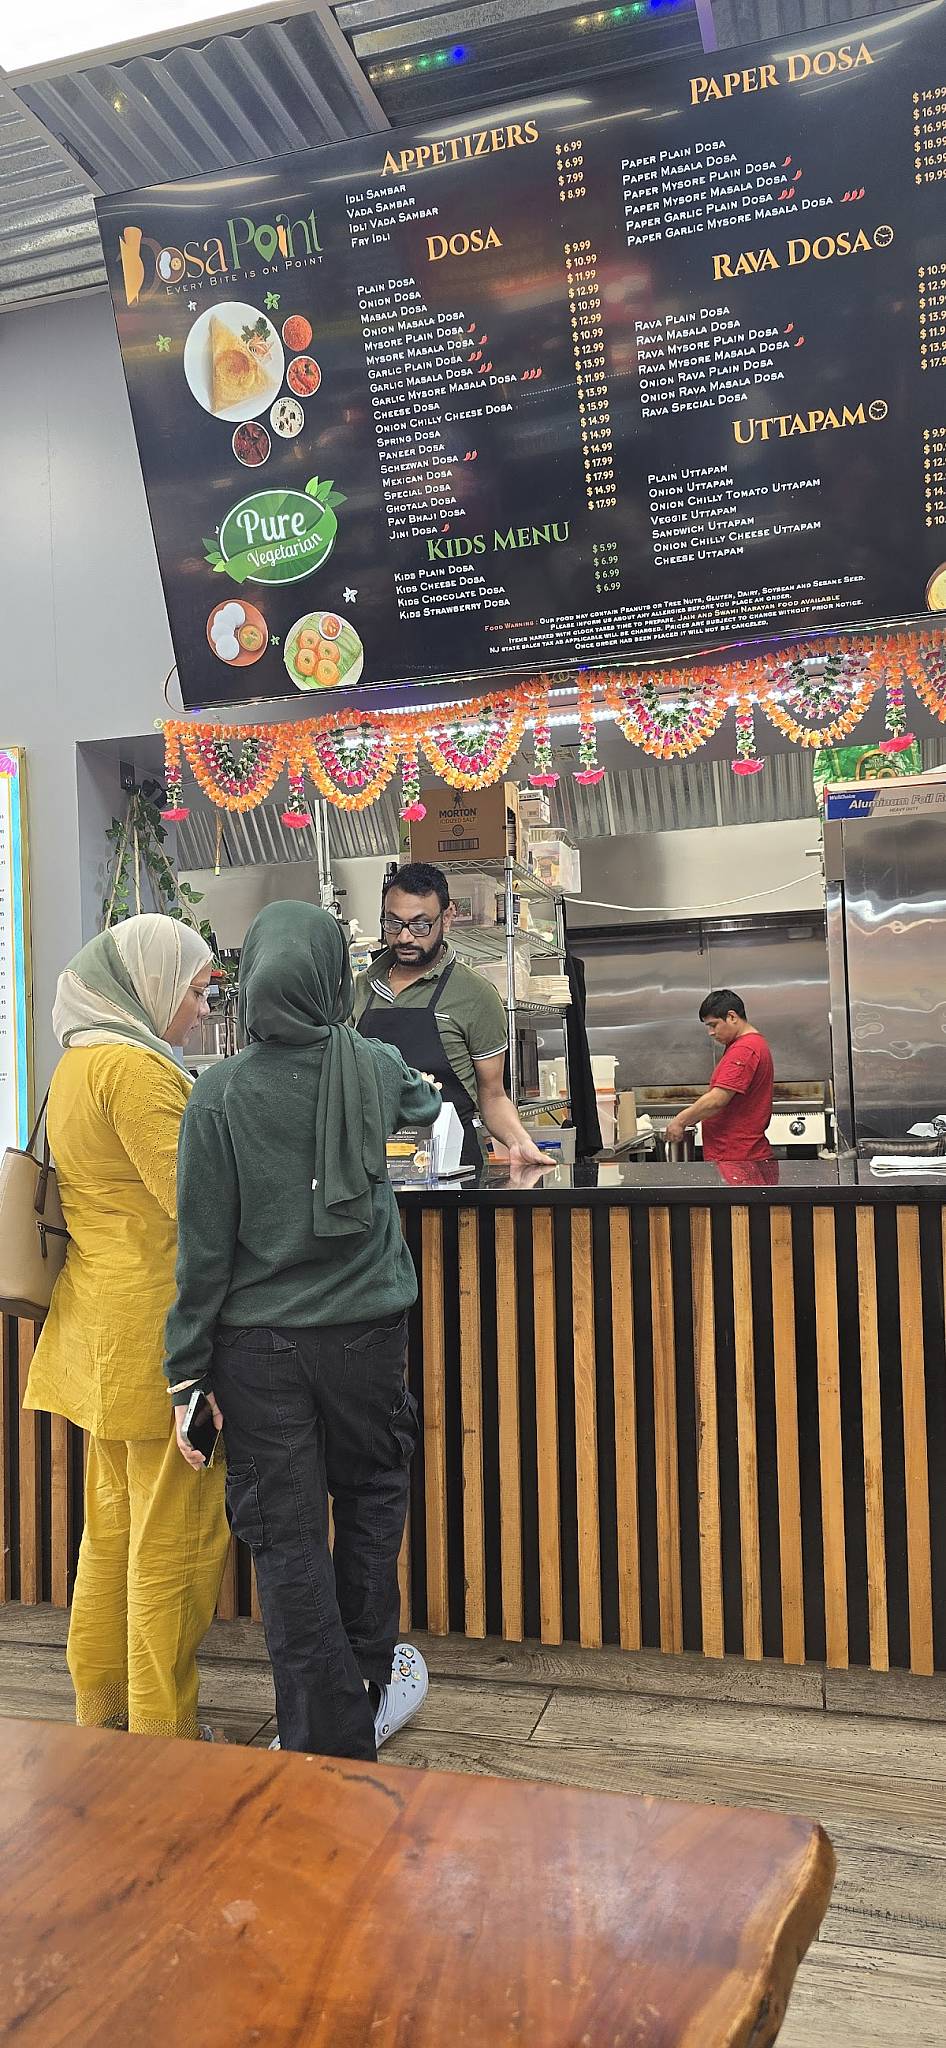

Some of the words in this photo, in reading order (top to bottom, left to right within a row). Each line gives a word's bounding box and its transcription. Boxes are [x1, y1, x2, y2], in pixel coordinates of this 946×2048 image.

[688, 64, 780, 105] PAPER
[787, 42, 874, 83] DOSA
[381, 120, 539, 177] APPETIZERS
[425, 225, 503, 261] DOSA
[711, 247, 781, 281] RAVA
[787, 229, 872, 266] DOSA
[732, 403, 867, 444] UTTAPAM
[236, 509, 308, 545] Pure
[426, 535, 485, 561] KIDS
[493, 521, 571, 551] MENU
[247, 532, 323, 568] Vegetarian
[439, 808, 477, 819] MORTON
